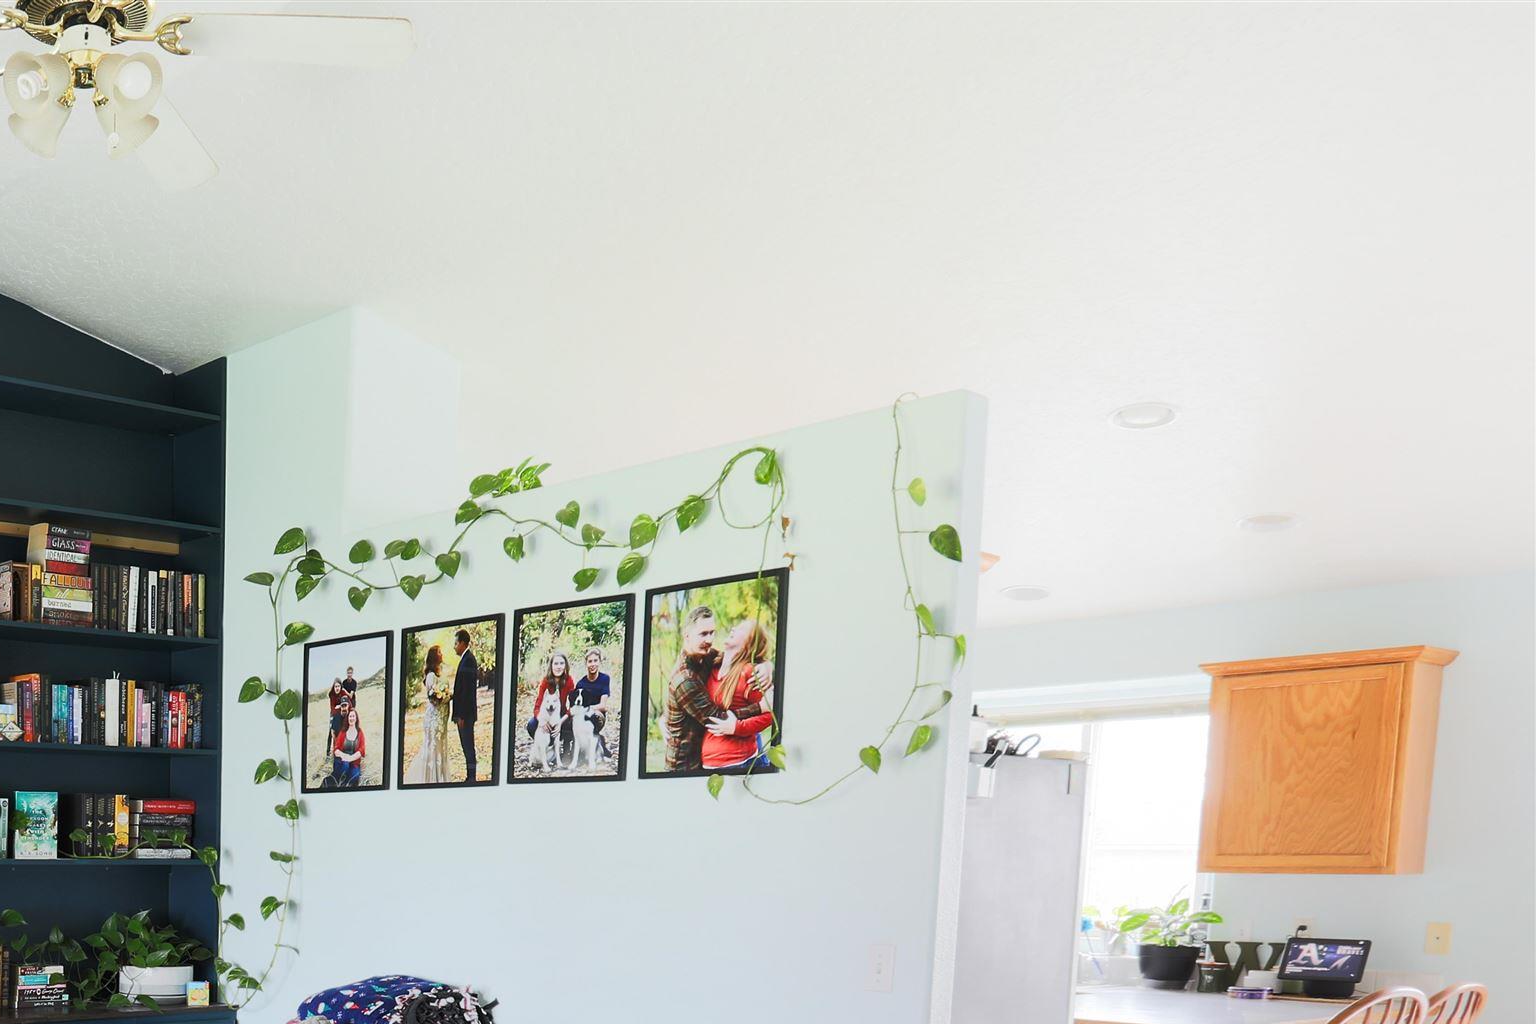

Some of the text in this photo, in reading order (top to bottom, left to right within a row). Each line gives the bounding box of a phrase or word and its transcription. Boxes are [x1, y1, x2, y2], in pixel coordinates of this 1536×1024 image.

[52, 538, 75, 550] GLASS
[47, 550, 77, 562] IDENTICAL
[44, 573, 92, 588] FALLOUT
